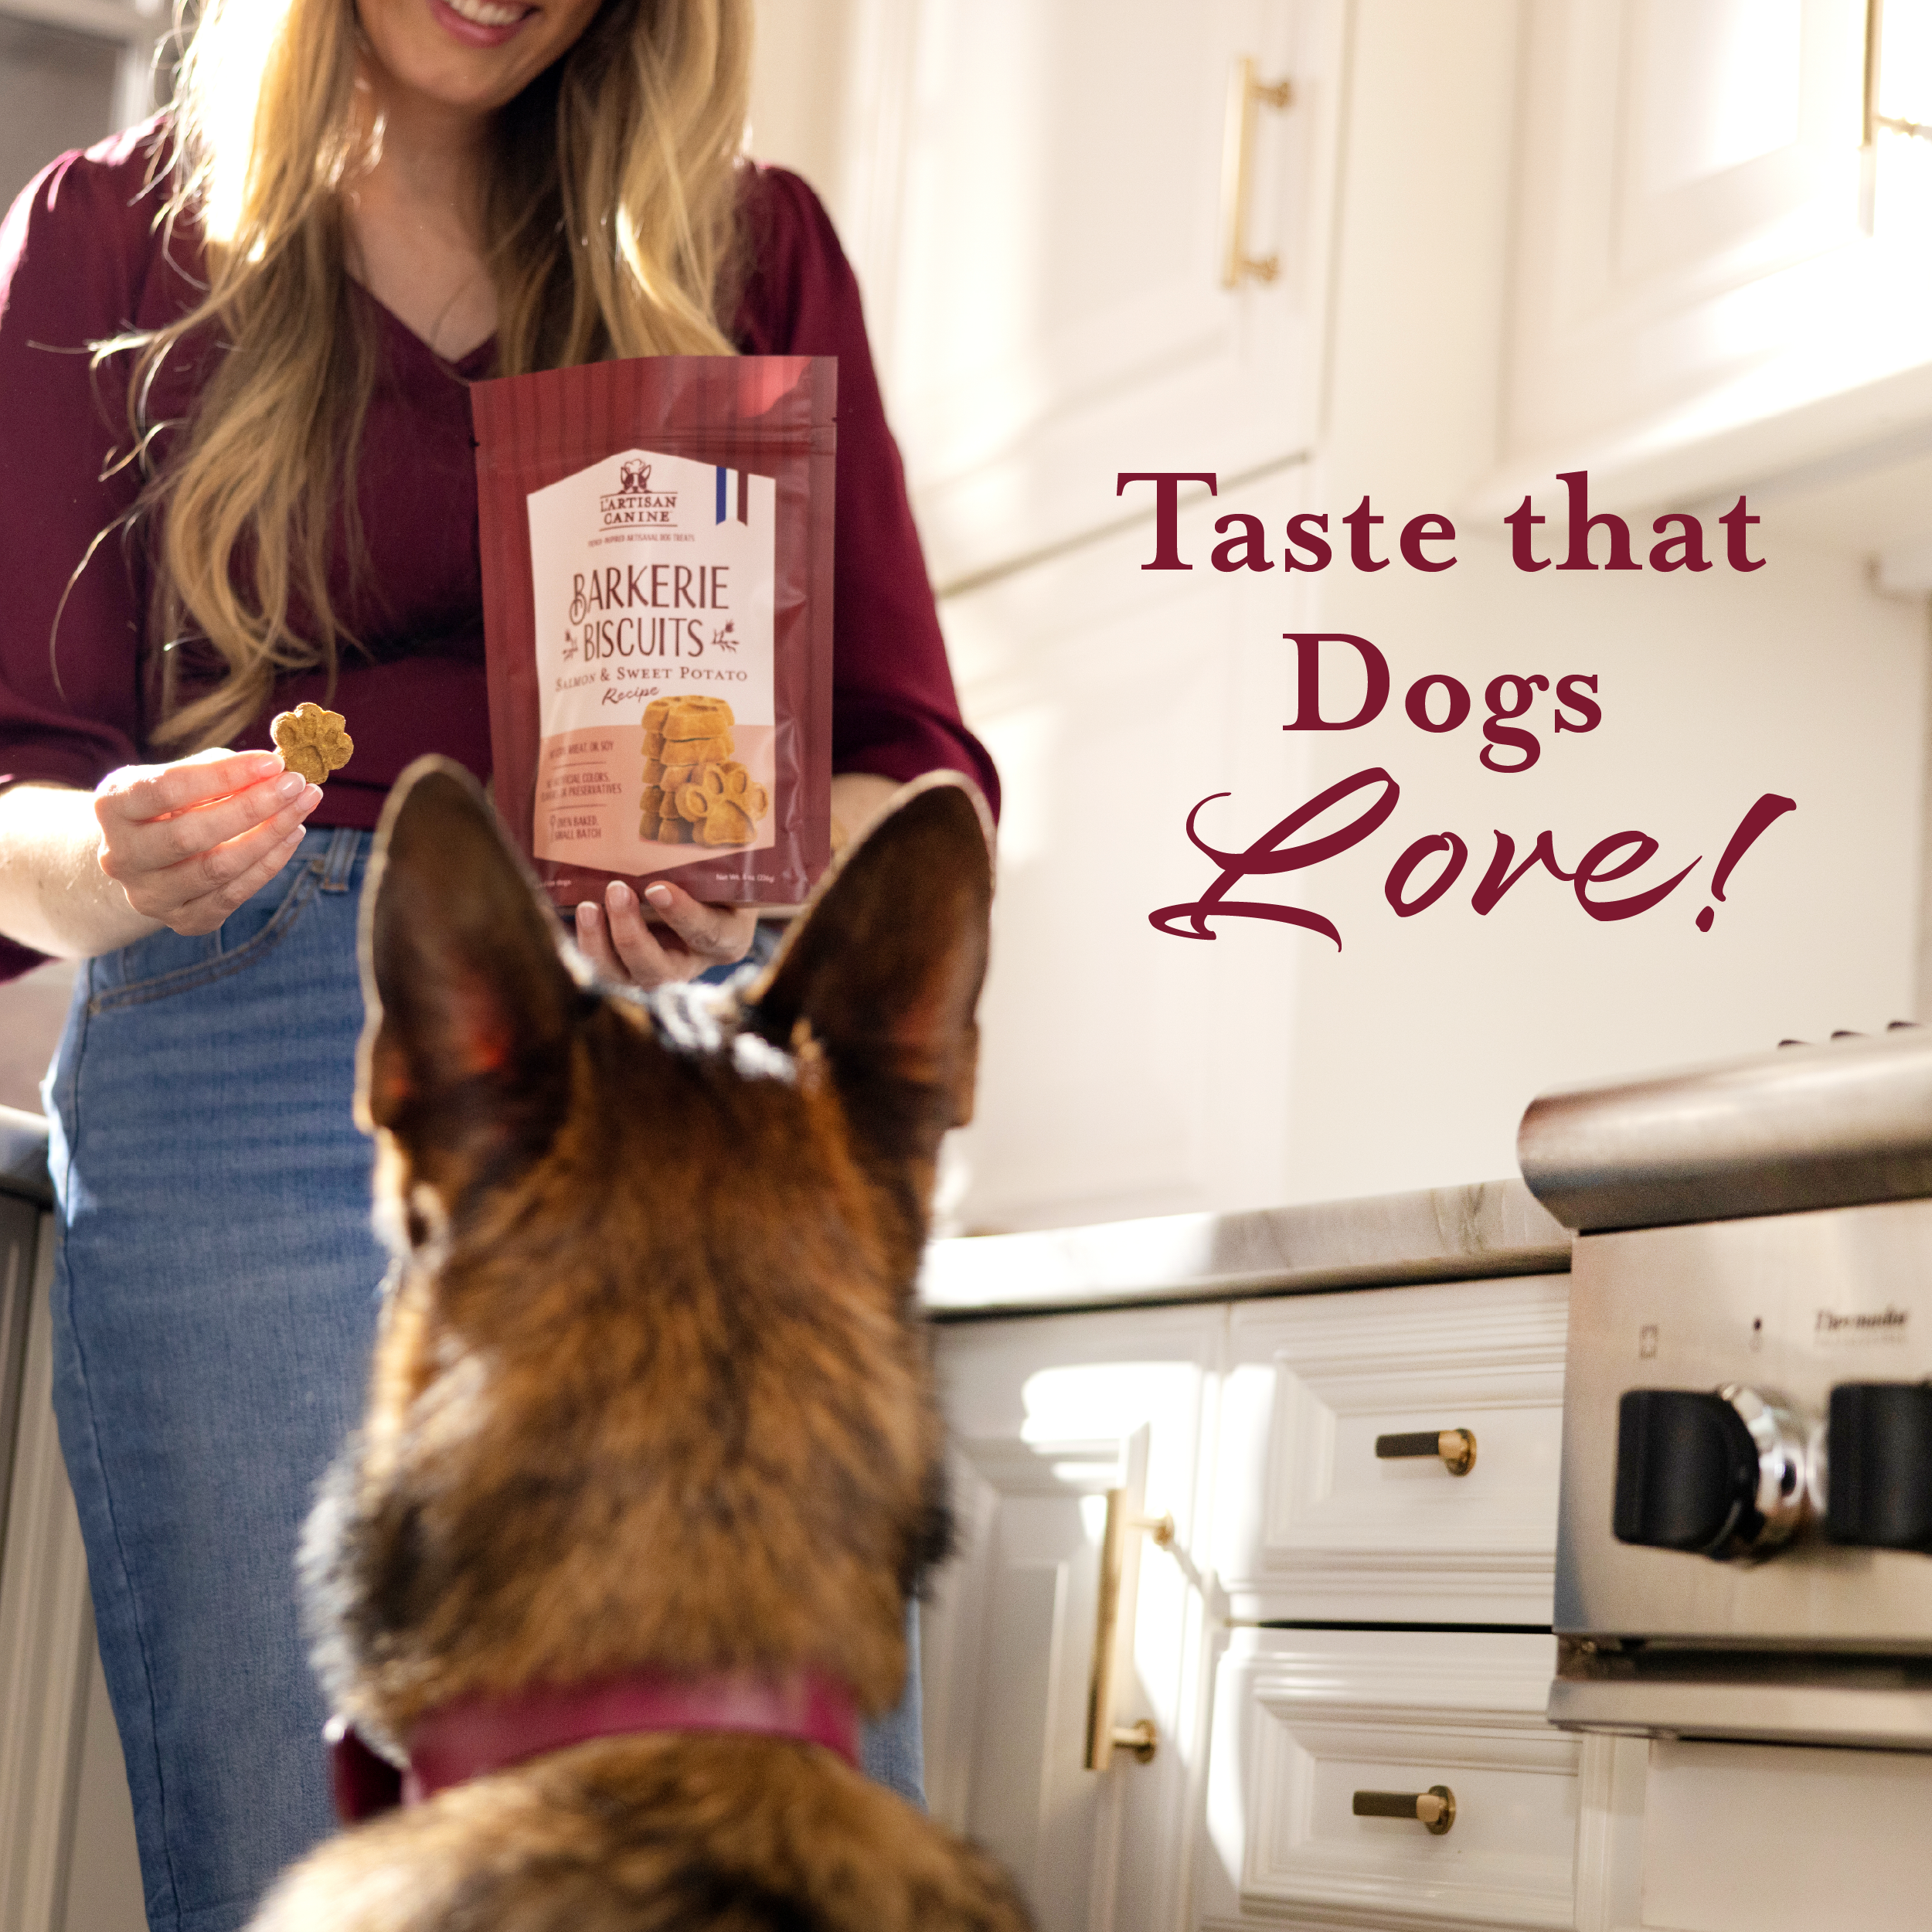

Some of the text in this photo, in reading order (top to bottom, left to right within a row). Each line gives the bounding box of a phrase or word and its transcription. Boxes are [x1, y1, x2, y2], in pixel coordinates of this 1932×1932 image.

[600, 496, 677, 512] L'ARTISAN
[604, 511, 670, 525] CANINE
[569, 564, 730, 626] BARKERIE
[583, 617, 705, 662] BISCUITS
[600, 667, 611, 682] &
[601, 686, 660, 706] Recipe
